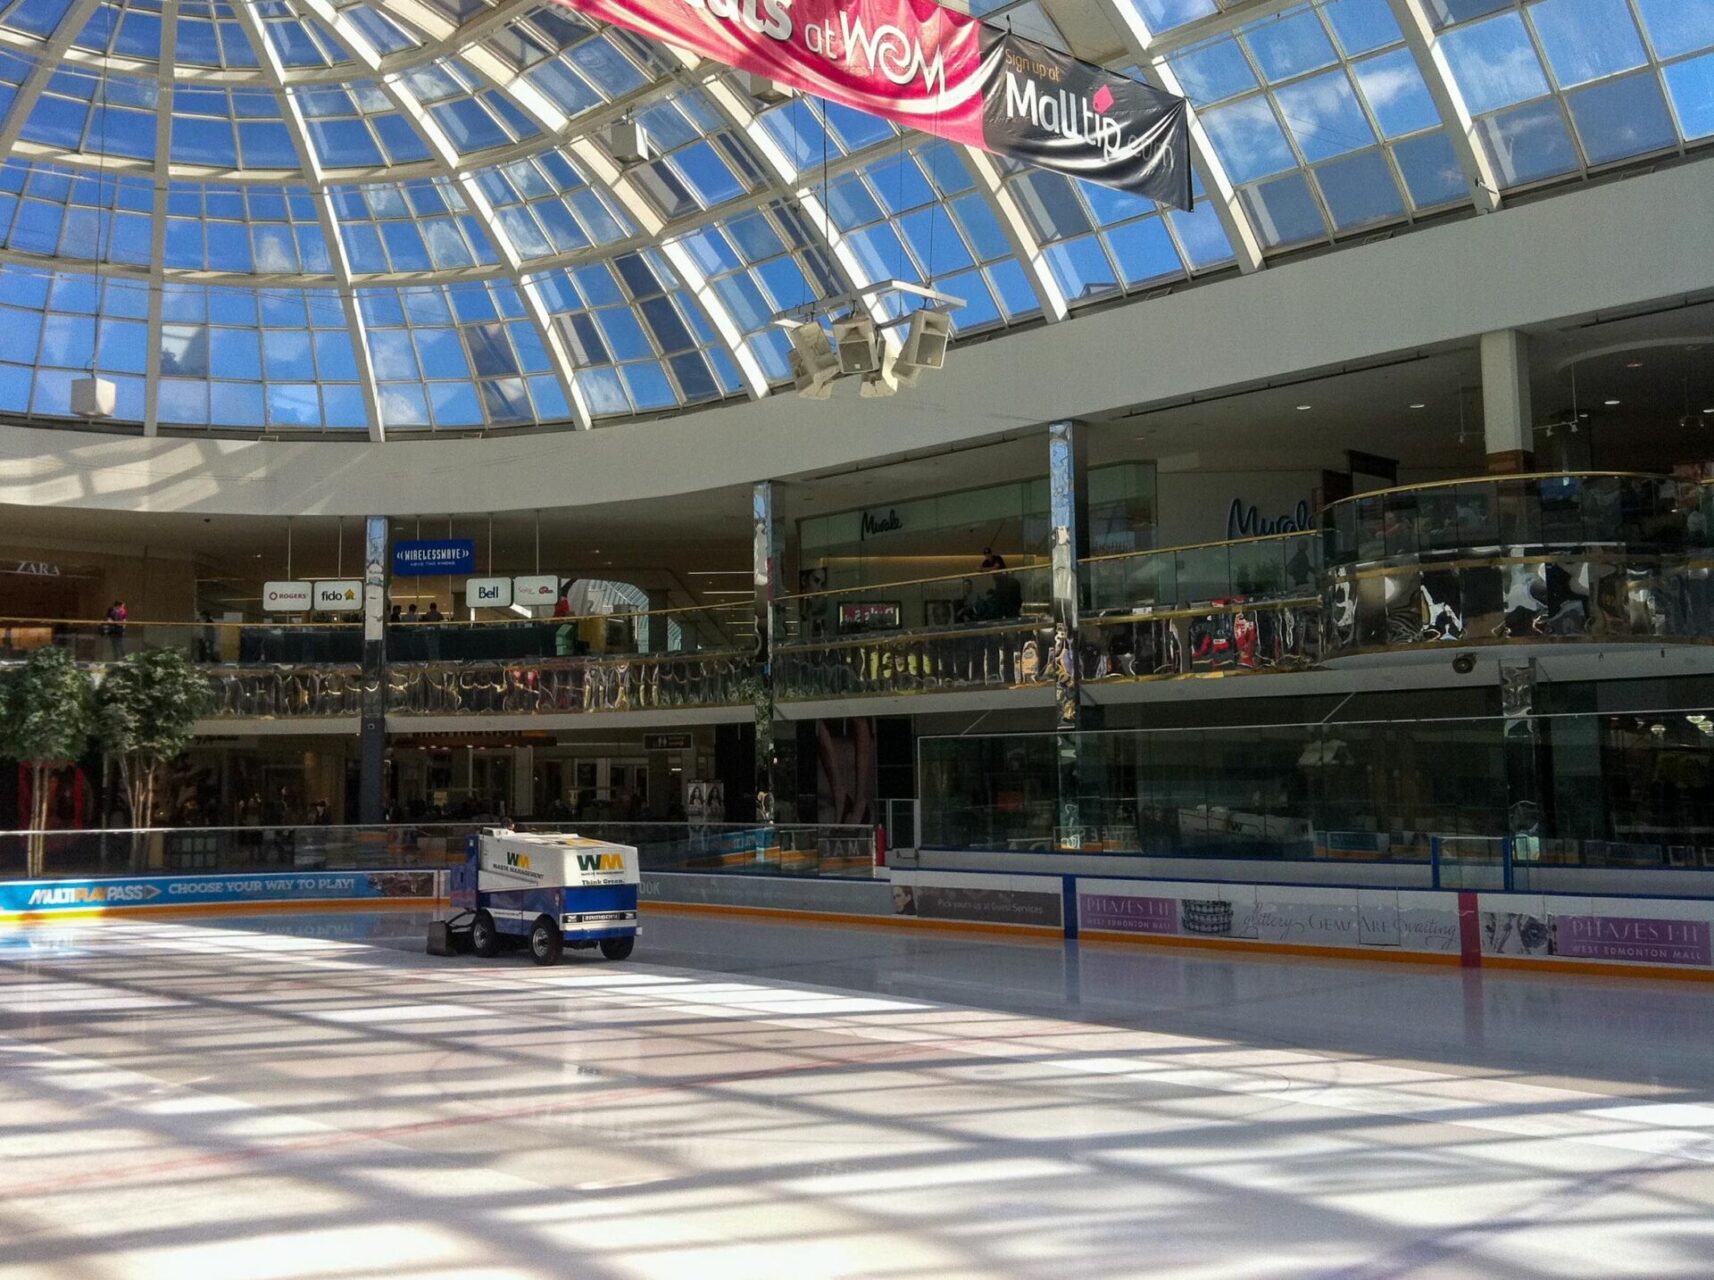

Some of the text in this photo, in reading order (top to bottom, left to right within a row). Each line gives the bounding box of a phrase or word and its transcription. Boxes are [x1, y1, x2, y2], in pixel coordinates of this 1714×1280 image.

[805, 19, 837, 59] at
[839, 11, 946, 103] WOM
[1006, 49, 1030, 73] Sign
[1033, 61, 1046, 79] up
[16, 561, 60, 576] ZARA
[321, 590, 343, 601] fido
[478, 586, 499, 599] Bell
[507, 851, 530, 870] WM
[576, 853, 624, 871] WM
[168, 878, 355, 895] CHOOSE YOUR WAY TO PLAY!
[1107, 920, 1149, 929] EDMONTON
[1604, 947, 1668, 958] EDMONTON
